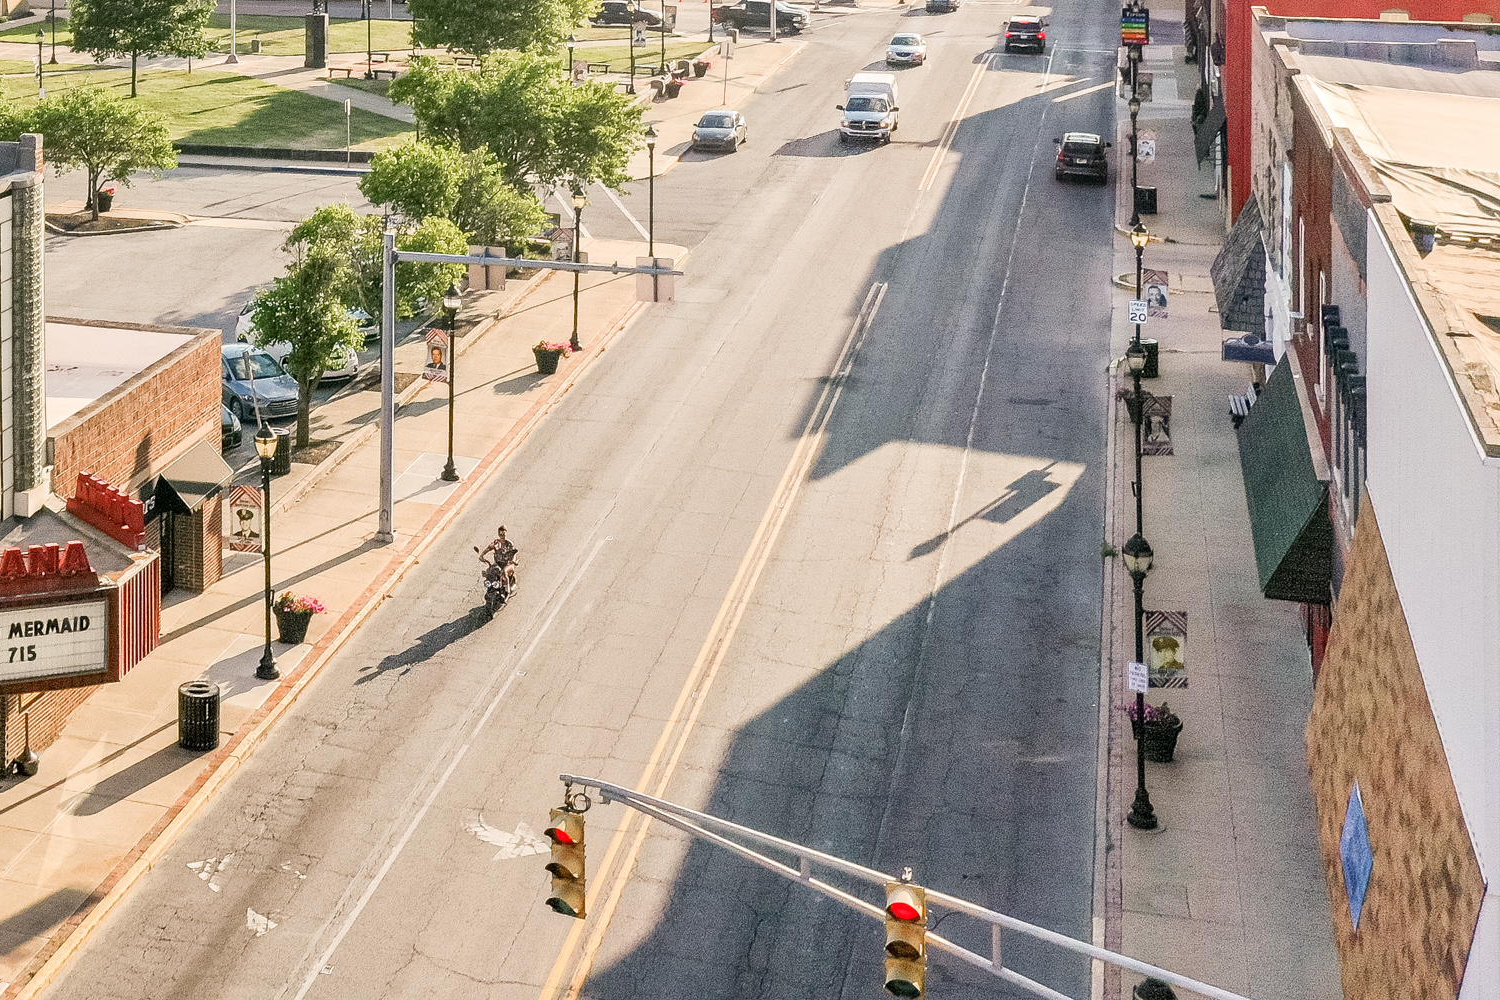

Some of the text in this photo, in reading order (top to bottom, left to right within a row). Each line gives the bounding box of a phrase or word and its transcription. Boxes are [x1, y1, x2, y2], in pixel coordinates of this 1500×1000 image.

[1130, 312, 1147, 322] 20
[8, 616, 91, 640] MERMAID
[8, 645, 37, 663] 715
